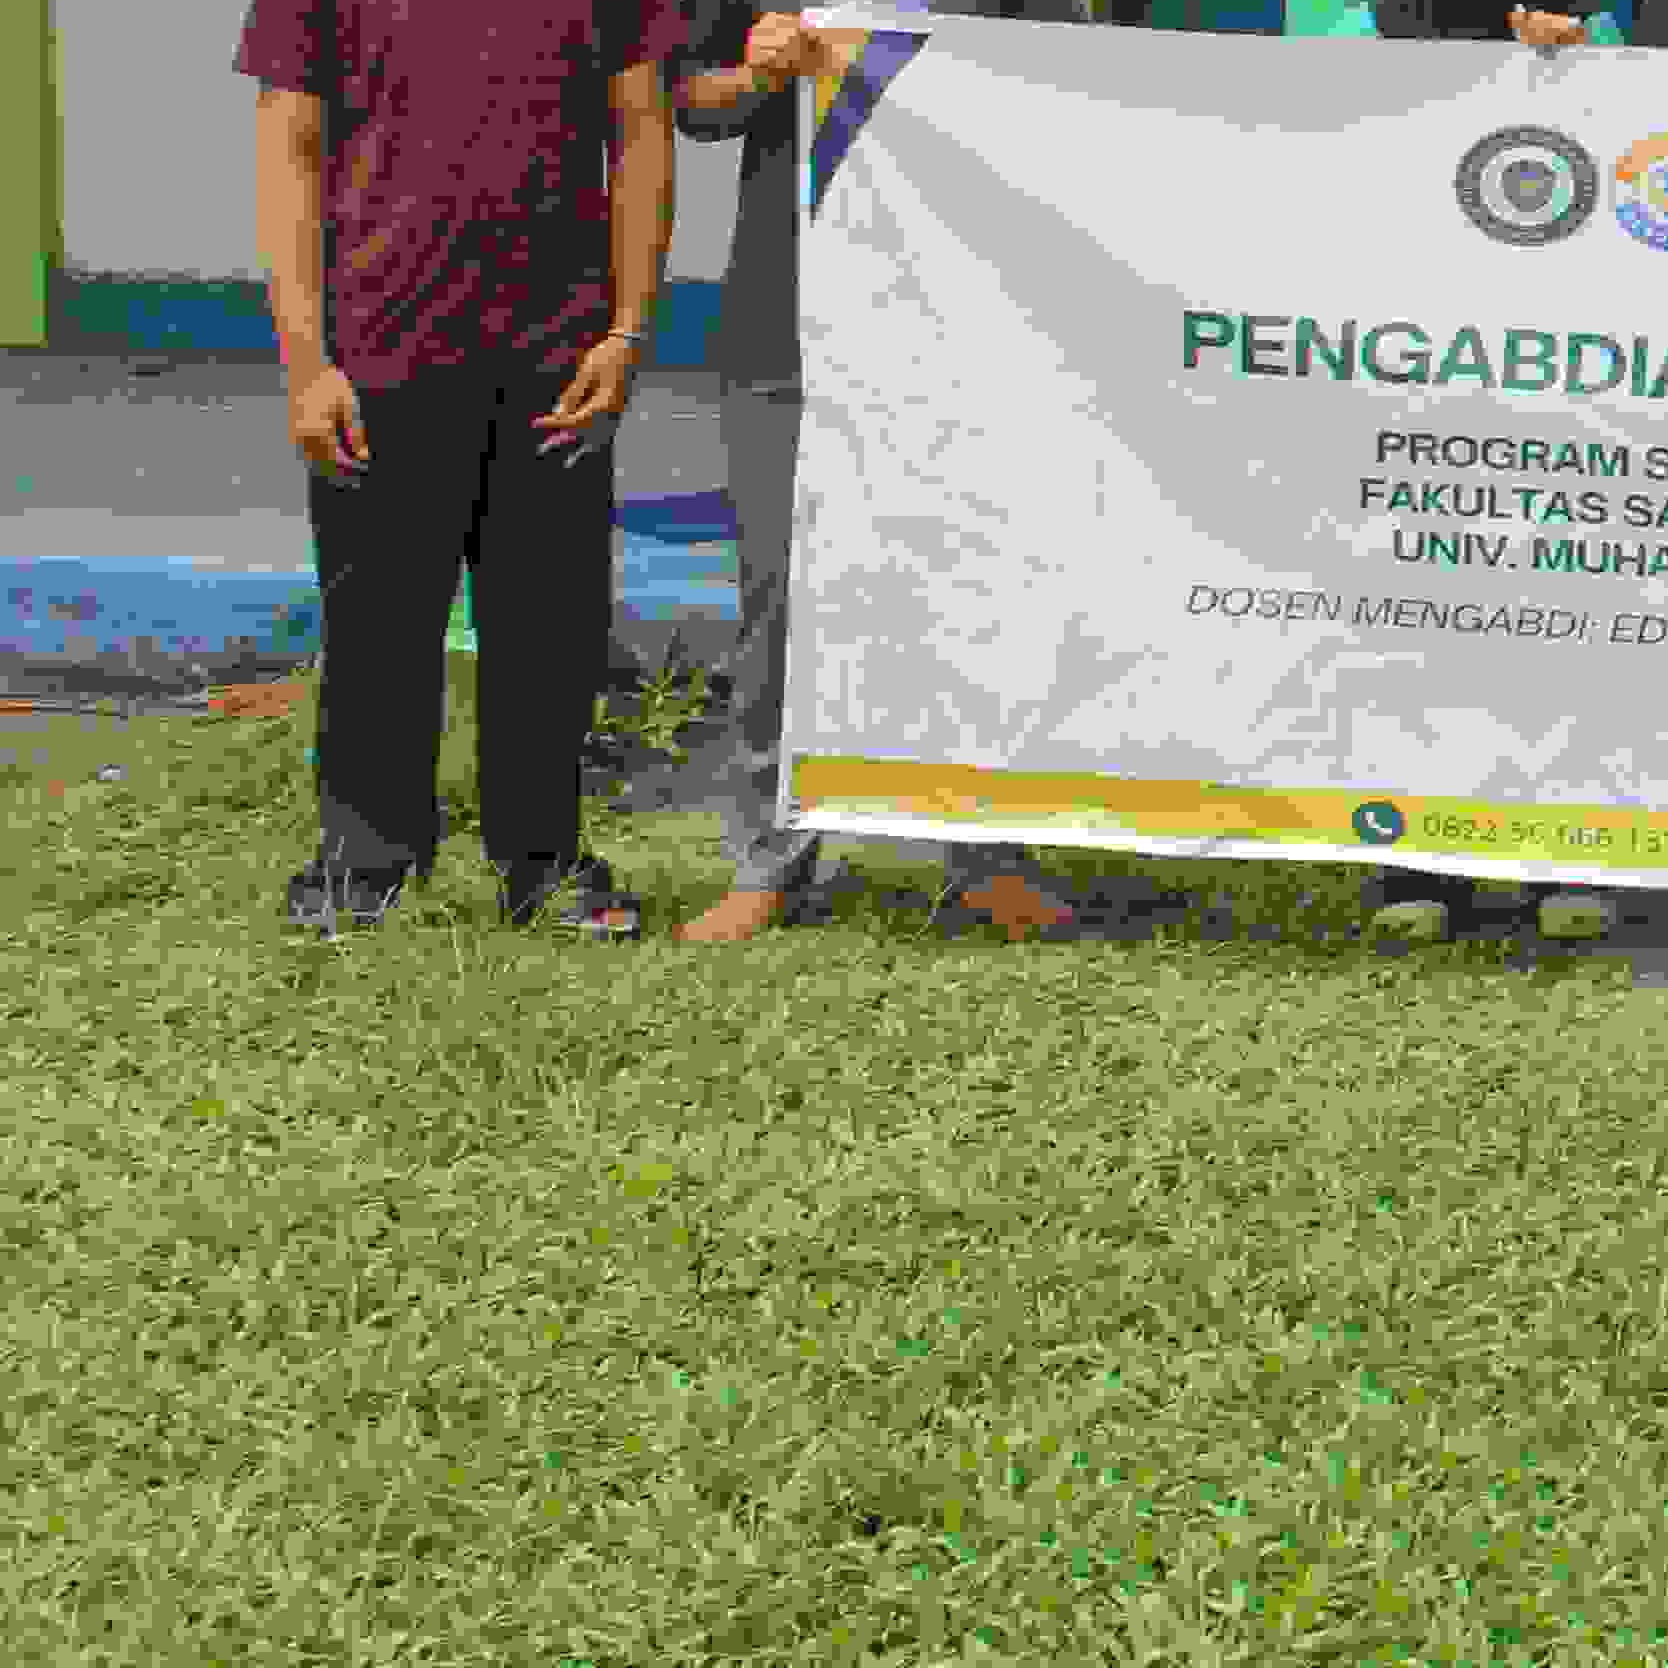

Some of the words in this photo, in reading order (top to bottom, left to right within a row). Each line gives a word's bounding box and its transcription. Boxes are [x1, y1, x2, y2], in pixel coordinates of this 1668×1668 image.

[1375, 430, 1631, 478] PROGRAM
[1358, 477, 1611, 525] FAKULTAS
[1392, 527, 1518, 572] UNIV.
[1184, 584, 1344, 624] DOSEN
